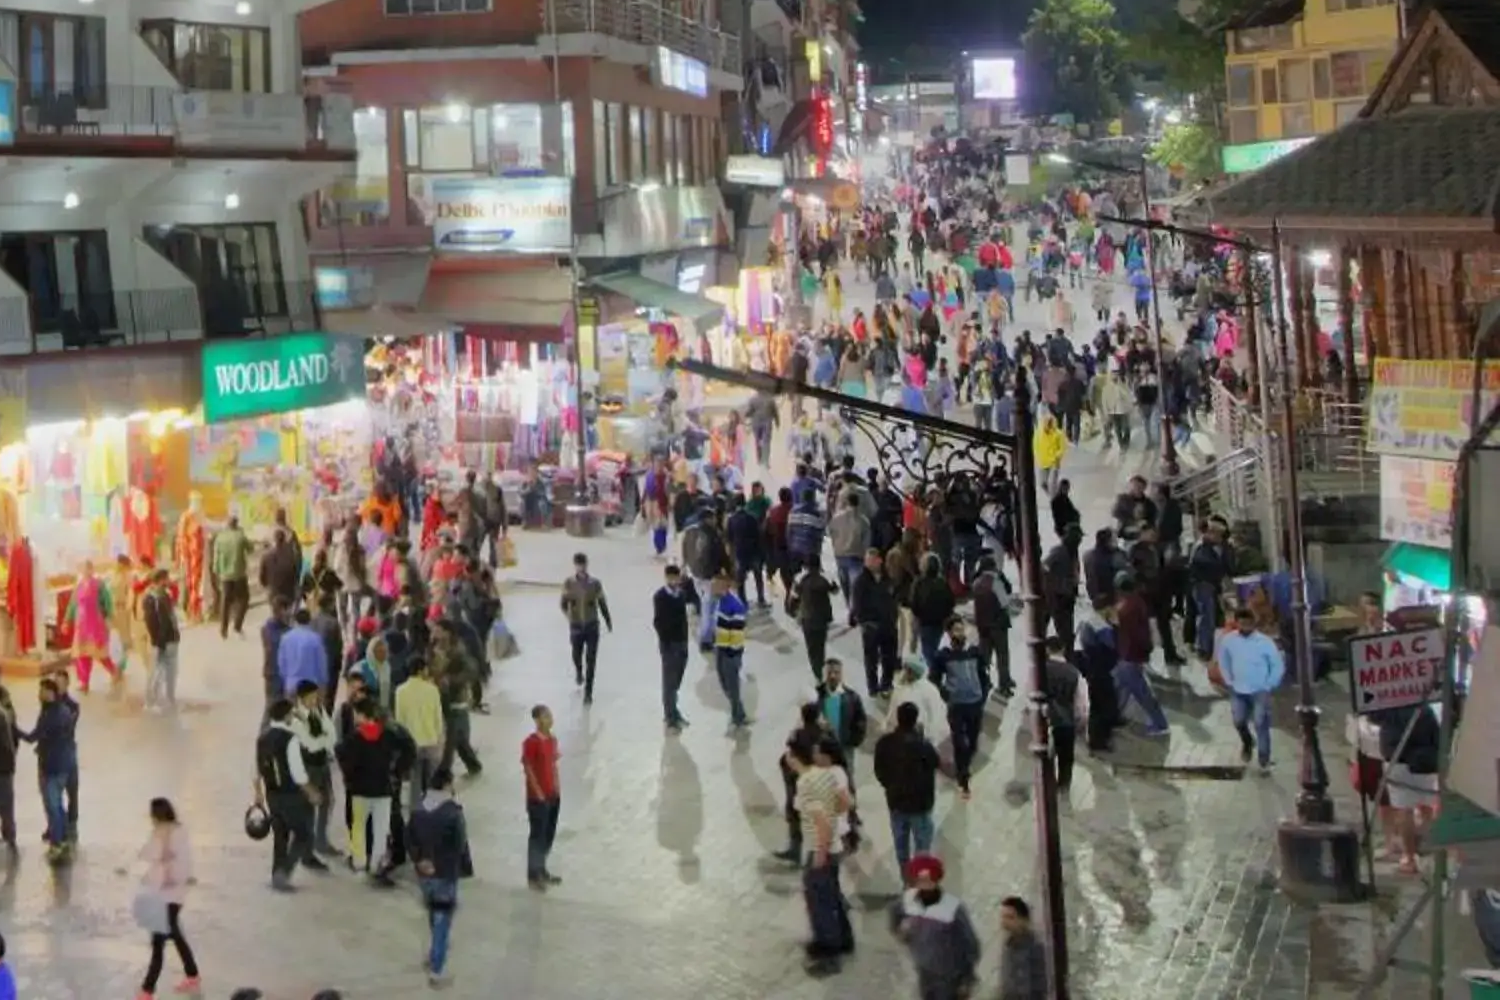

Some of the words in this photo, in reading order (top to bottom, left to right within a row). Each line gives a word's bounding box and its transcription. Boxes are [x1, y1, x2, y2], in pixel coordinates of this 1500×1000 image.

[215, 352, 329, 397] WOODLAND
[1364, 635, 1428, 662] NAC
[1359, 656, 1442, 686] MARKET
